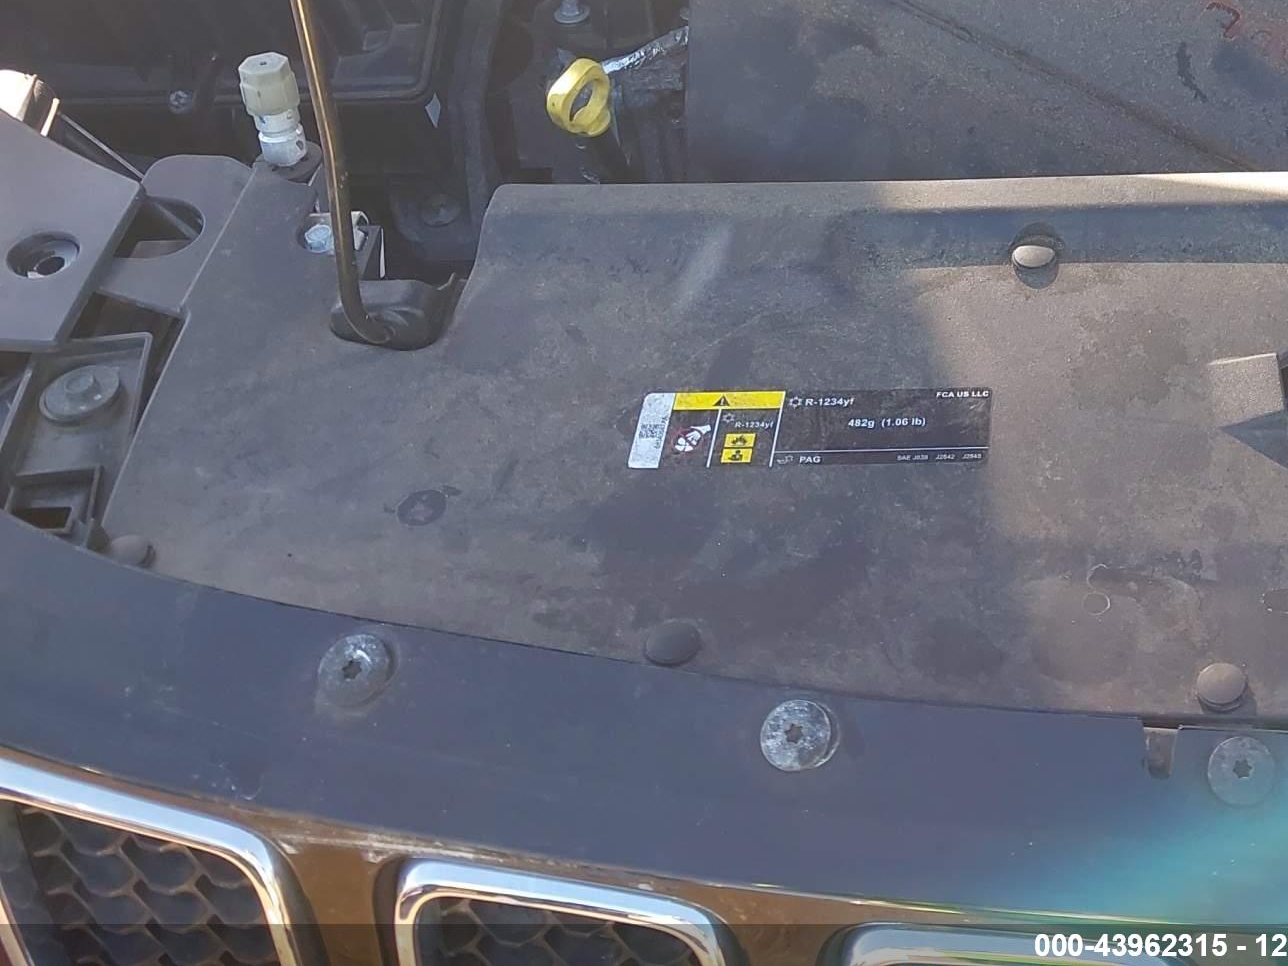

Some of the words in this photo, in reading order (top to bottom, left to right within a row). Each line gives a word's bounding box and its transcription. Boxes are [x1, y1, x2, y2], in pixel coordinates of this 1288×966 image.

[956, 390, 970, 398] US
[971, 390, 989, 398] LLC
[804, 397, 855, 408] R-1234yf
[848, 418, 876, 429] 482g
[881, 418, 909, 428] (1.06
[911, 417, 927, 427] lb)
[799, 455, 822, 464] PAG
